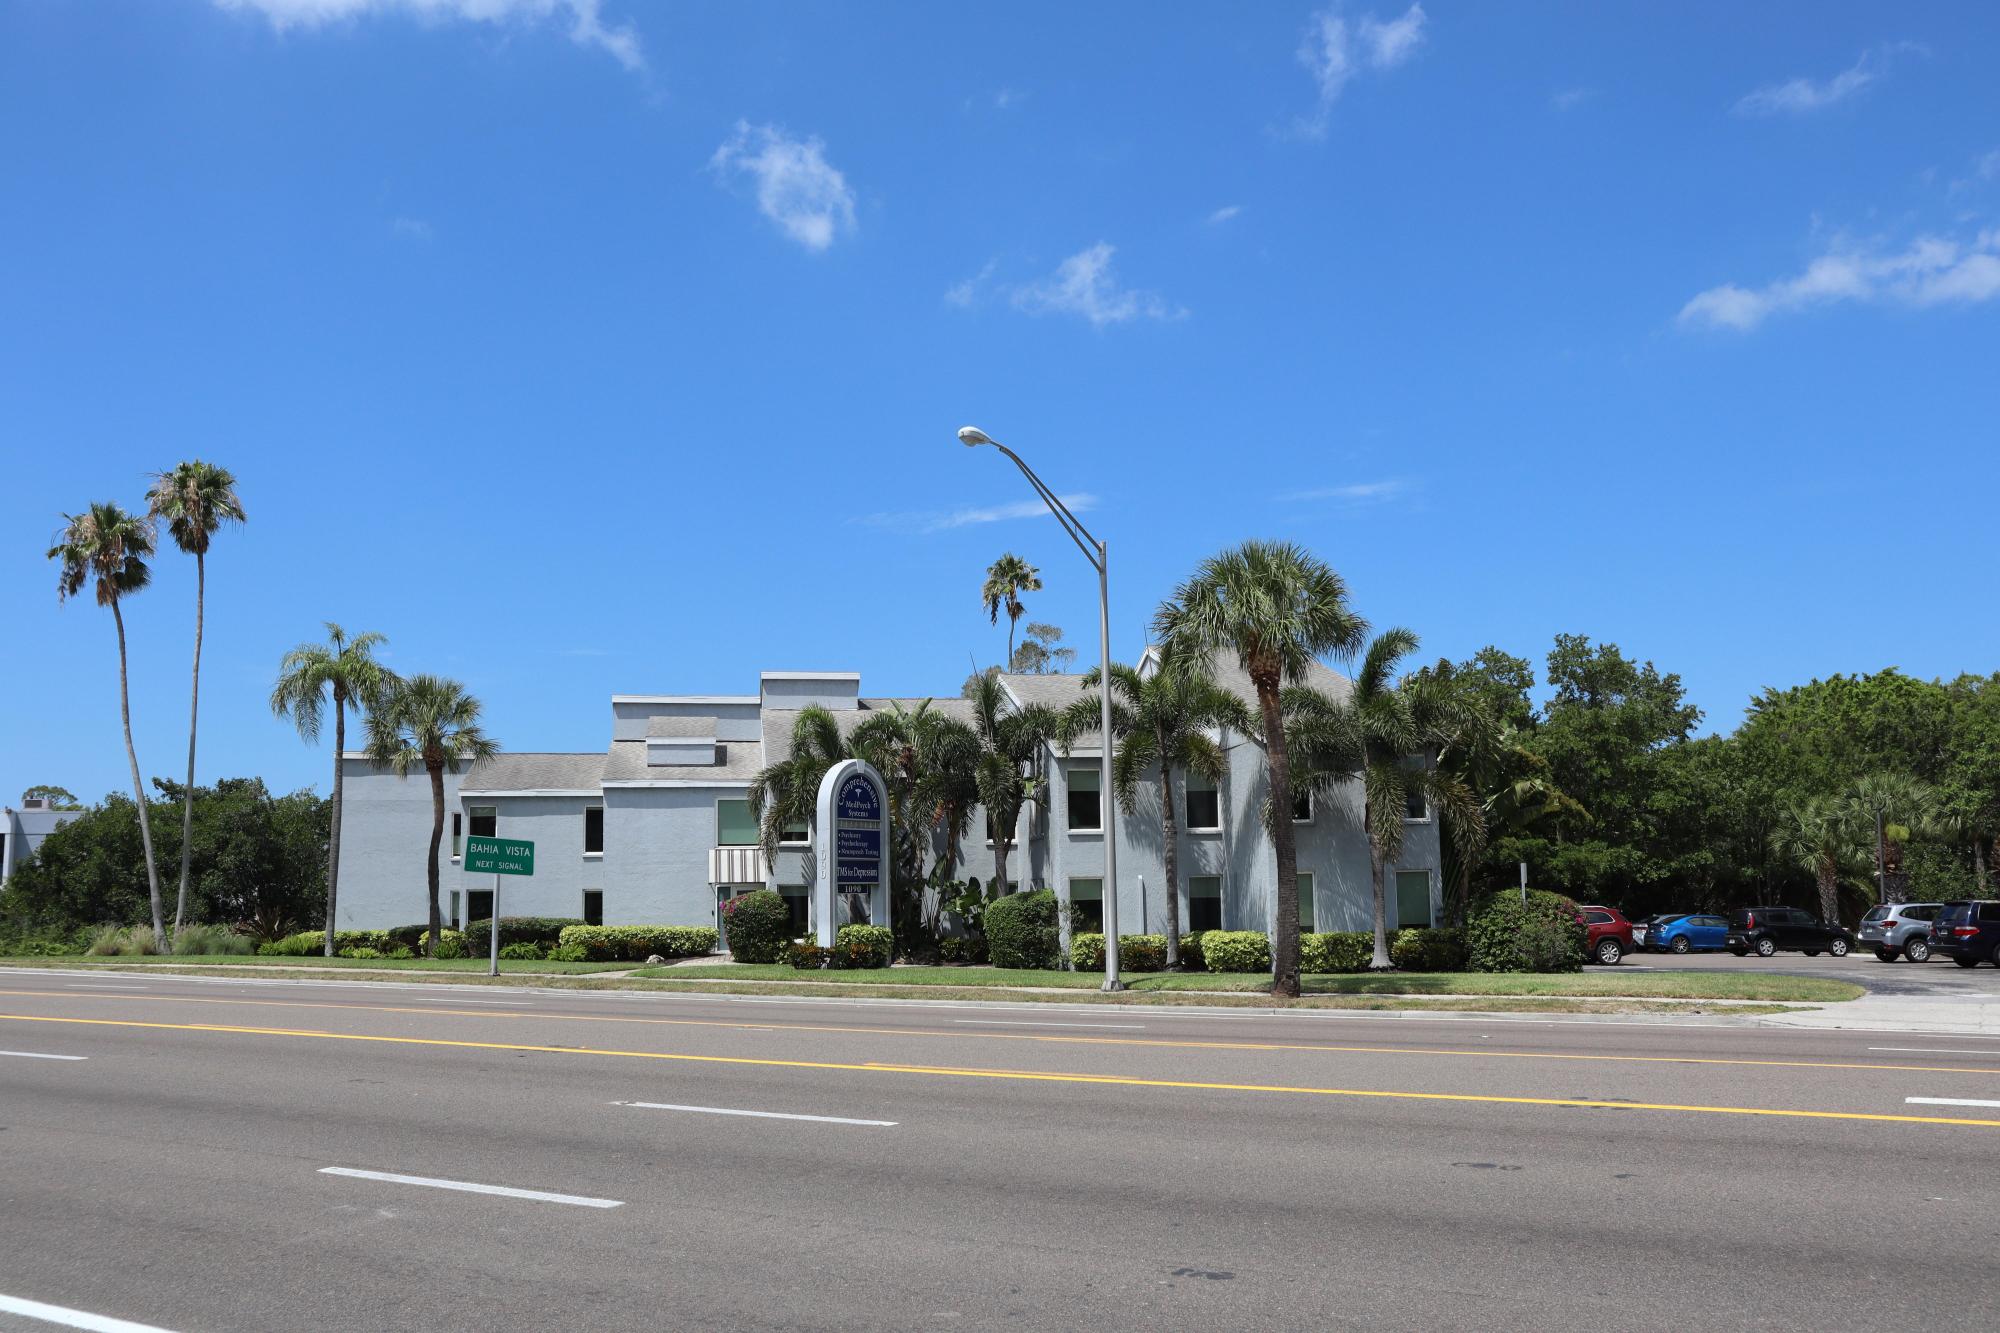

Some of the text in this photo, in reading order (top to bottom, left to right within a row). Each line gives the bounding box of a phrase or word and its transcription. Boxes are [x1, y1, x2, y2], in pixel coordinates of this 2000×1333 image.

[838, 777, 878, 808] Comprehensive
[845, 801, 871, 810] MedPsych
[848, 809, 868, 817] Systems
[470, 843, 531, 857] BAHIA VISTA
[475, 860, 524, 871] NEXT SIGNAL
[837, 866, 848, 877] TMS
[853, 866, 878, 879] Depression
[845, 885, 862, 893] 1090
